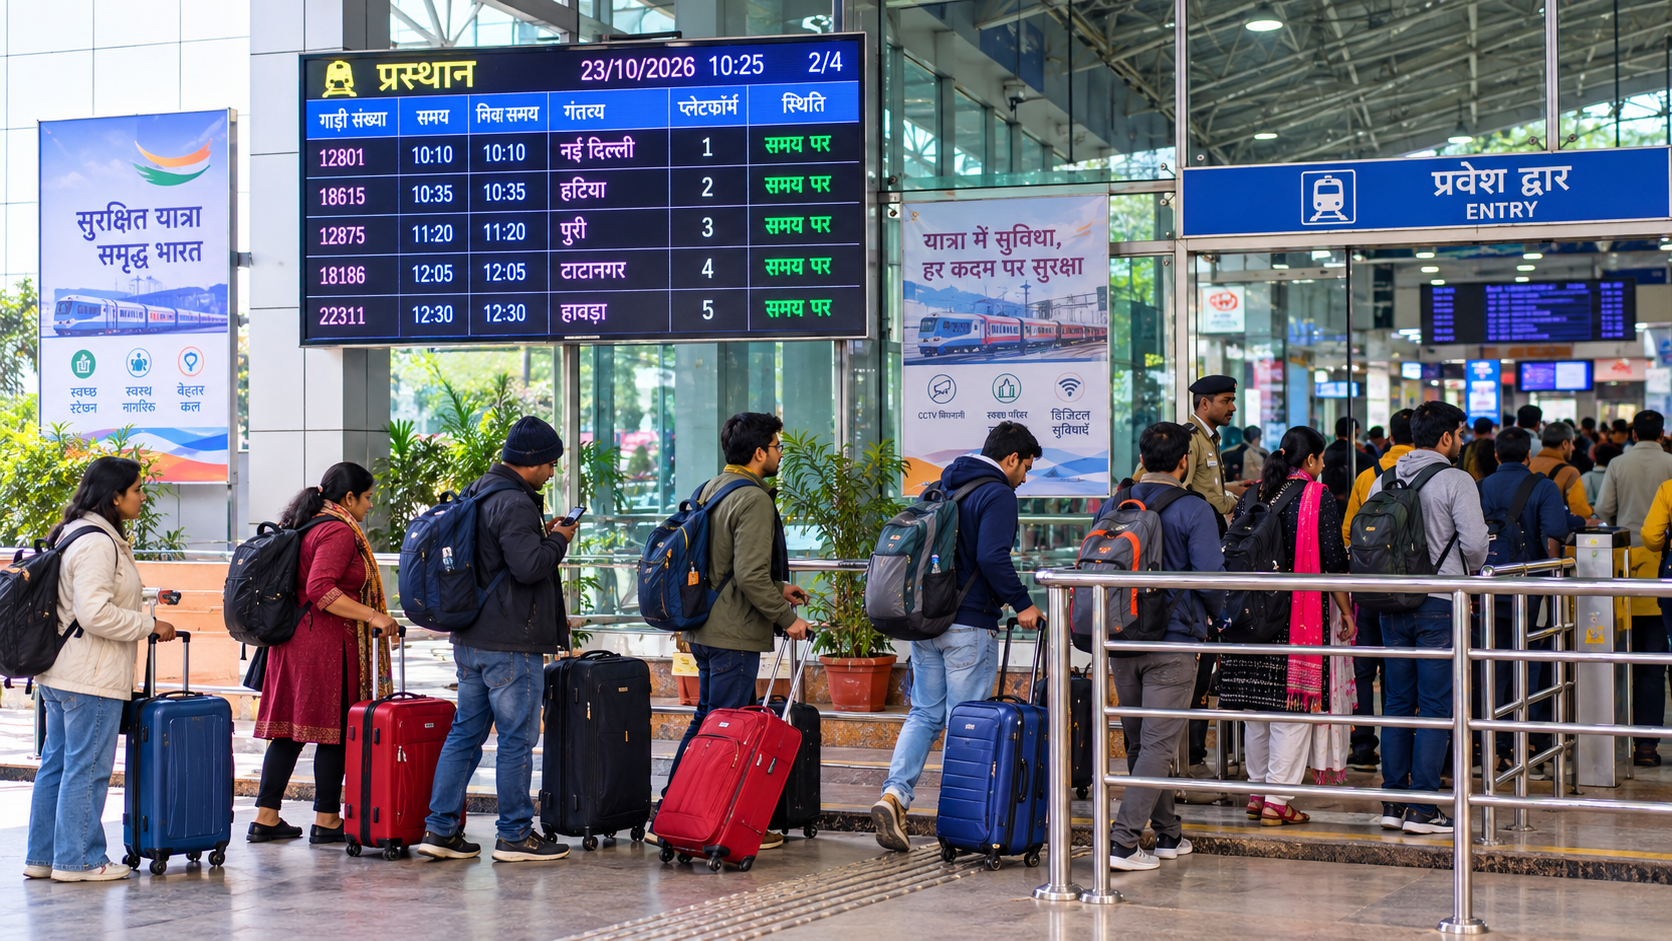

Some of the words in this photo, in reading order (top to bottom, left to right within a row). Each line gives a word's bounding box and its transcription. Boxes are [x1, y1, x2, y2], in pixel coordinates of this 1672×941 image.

[581, 56, 695, 81] 23/10/2026
[709, 54, 763, 76] 10:25
[809, 51, 843, 74] 2/4
[376, 61, 476, 91] प्रस्थान
[781, 91, 826, 113] स्थिति
[319, 108, 349, 132] गाड़ी
[351, 108, 388, 127] संख्या
[416, 110, 450, 125] समय
[505, 106, 540, 122] समय
[484, 143, 525, 161] 10:10
[560, 137, 583, 163] नई
[587, 136, 635, 160] दिल्ली
[703, 137, 712, 156] 1
[765, 136, 804, 153] समय
[809, 135, 831, 152] पर
[320, 148, 364, 167] 12801
[412, 146, 452, 164] 10:10
[702, 177, 713, 197] 2
[765, 176, 804, 194] समय
[809, 176, 831, 192] पर
[1431, 161, 1507, 196] प्रवेश
[1518, 166, 1572, 196] द्वार
[320, 187, 365, 205] 18615
[412, 185, 452, 203] 10:35
[484, 183, 525, 201] 10:35
[560, 177, 607, 201] हटिया
[1467, 201, 1537, 219] ENTRY
[76, 201, 149, 241] सुरक्षित
[155, 206, 202, 228] यात्रा
[702, 217, 713, 237] 3
[765, 217, 804, 234] समय
[810, 216, 832, 233] पर
[320, 226, 365, 245] 12875
[413, 224, 453, 242] 11:20
[484, 223, 525, 241] 11:20
[560, 216, 587, 246] पुरी
[923, 233, 967, 250] यात्रा
[972, 225, 988, 249] में
[97, 243, 149, 274] समृद्ध
[155, 241, 203, 263] भारत
[320, 266, 365, 284] 18186
[413, 265, 453, 282] 12:05
[484, 263, 525, 281] 12:05
[561, 262, 626, 279] टाटानगर
[702, 258, 713, 278] 4
[765, 258, 804, 276] समय
[810, 258, 832, 274] पर
[922, 262, 945, 281] हर
[950, 260, 997, 279] कदम
[1002, 260, 1026, 277] पर
[1031, 258, 1084, 283] सुरक्षा
[320, 307, 365, 325] 22311
[413, 305, 453, 323] 12:30
[484, 304, 525, 322] 12:30
[561, 304, 607, 324] हावड़ा
[703, 300, 713, 320] 5
[765, 300, 805, 317] समय
[810, 299, 832, 316] पर
[180, 402, 200, 412] कल
[1051, 408, 1090, 420] डिजिटल
